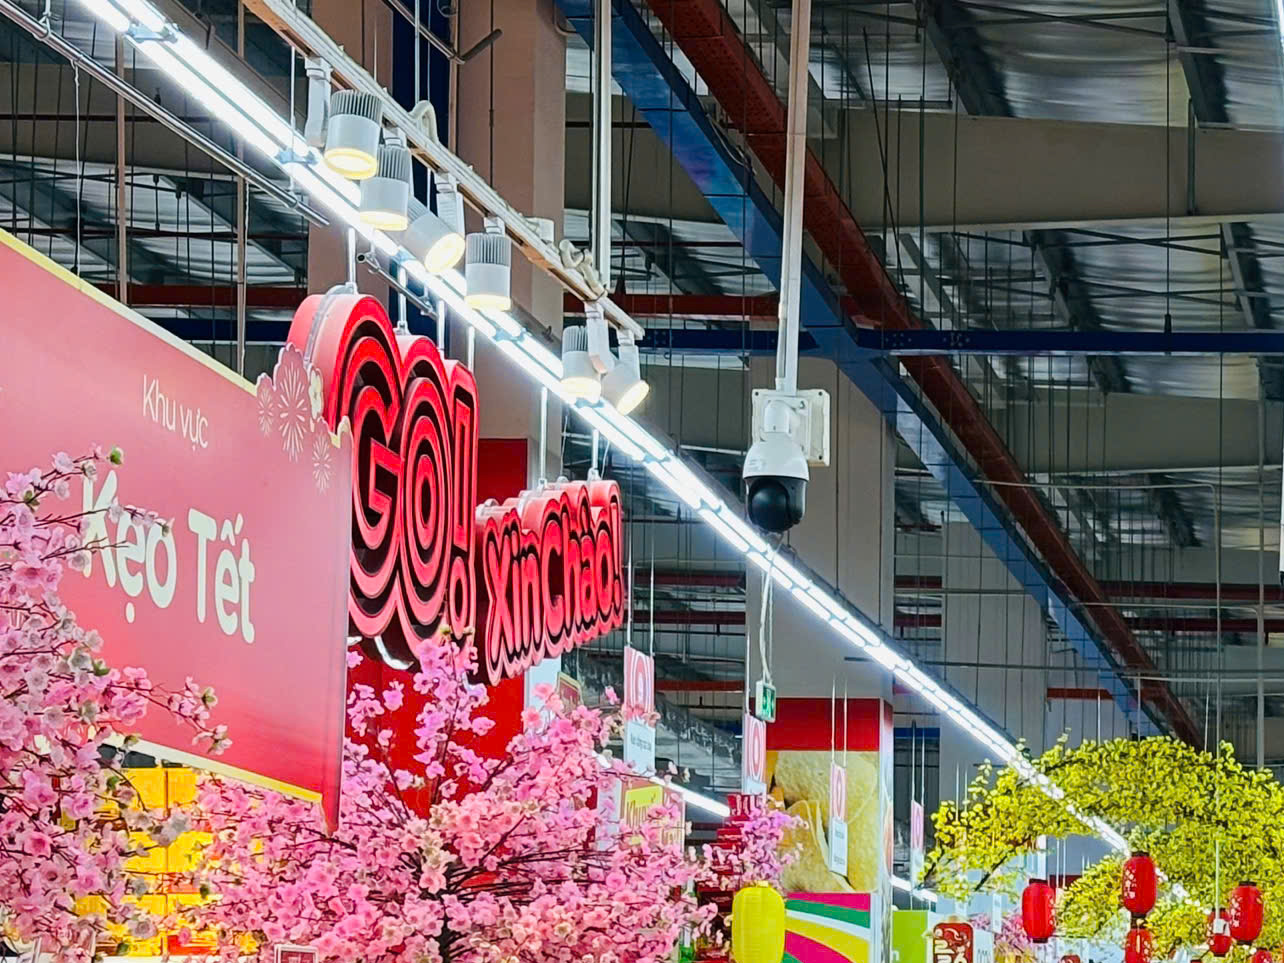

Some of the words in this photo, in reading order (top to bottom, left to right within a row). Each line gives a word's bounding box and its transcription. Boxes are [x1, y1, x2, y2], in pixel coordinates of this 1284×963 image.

[143, 374, 176, 431] Khu
[179, 404, 209, 452] vực
[331, 296, 478, 662] GO!
[82, 469, 177, 624] Kẹo
[188, 507, 255, 644] Tết
